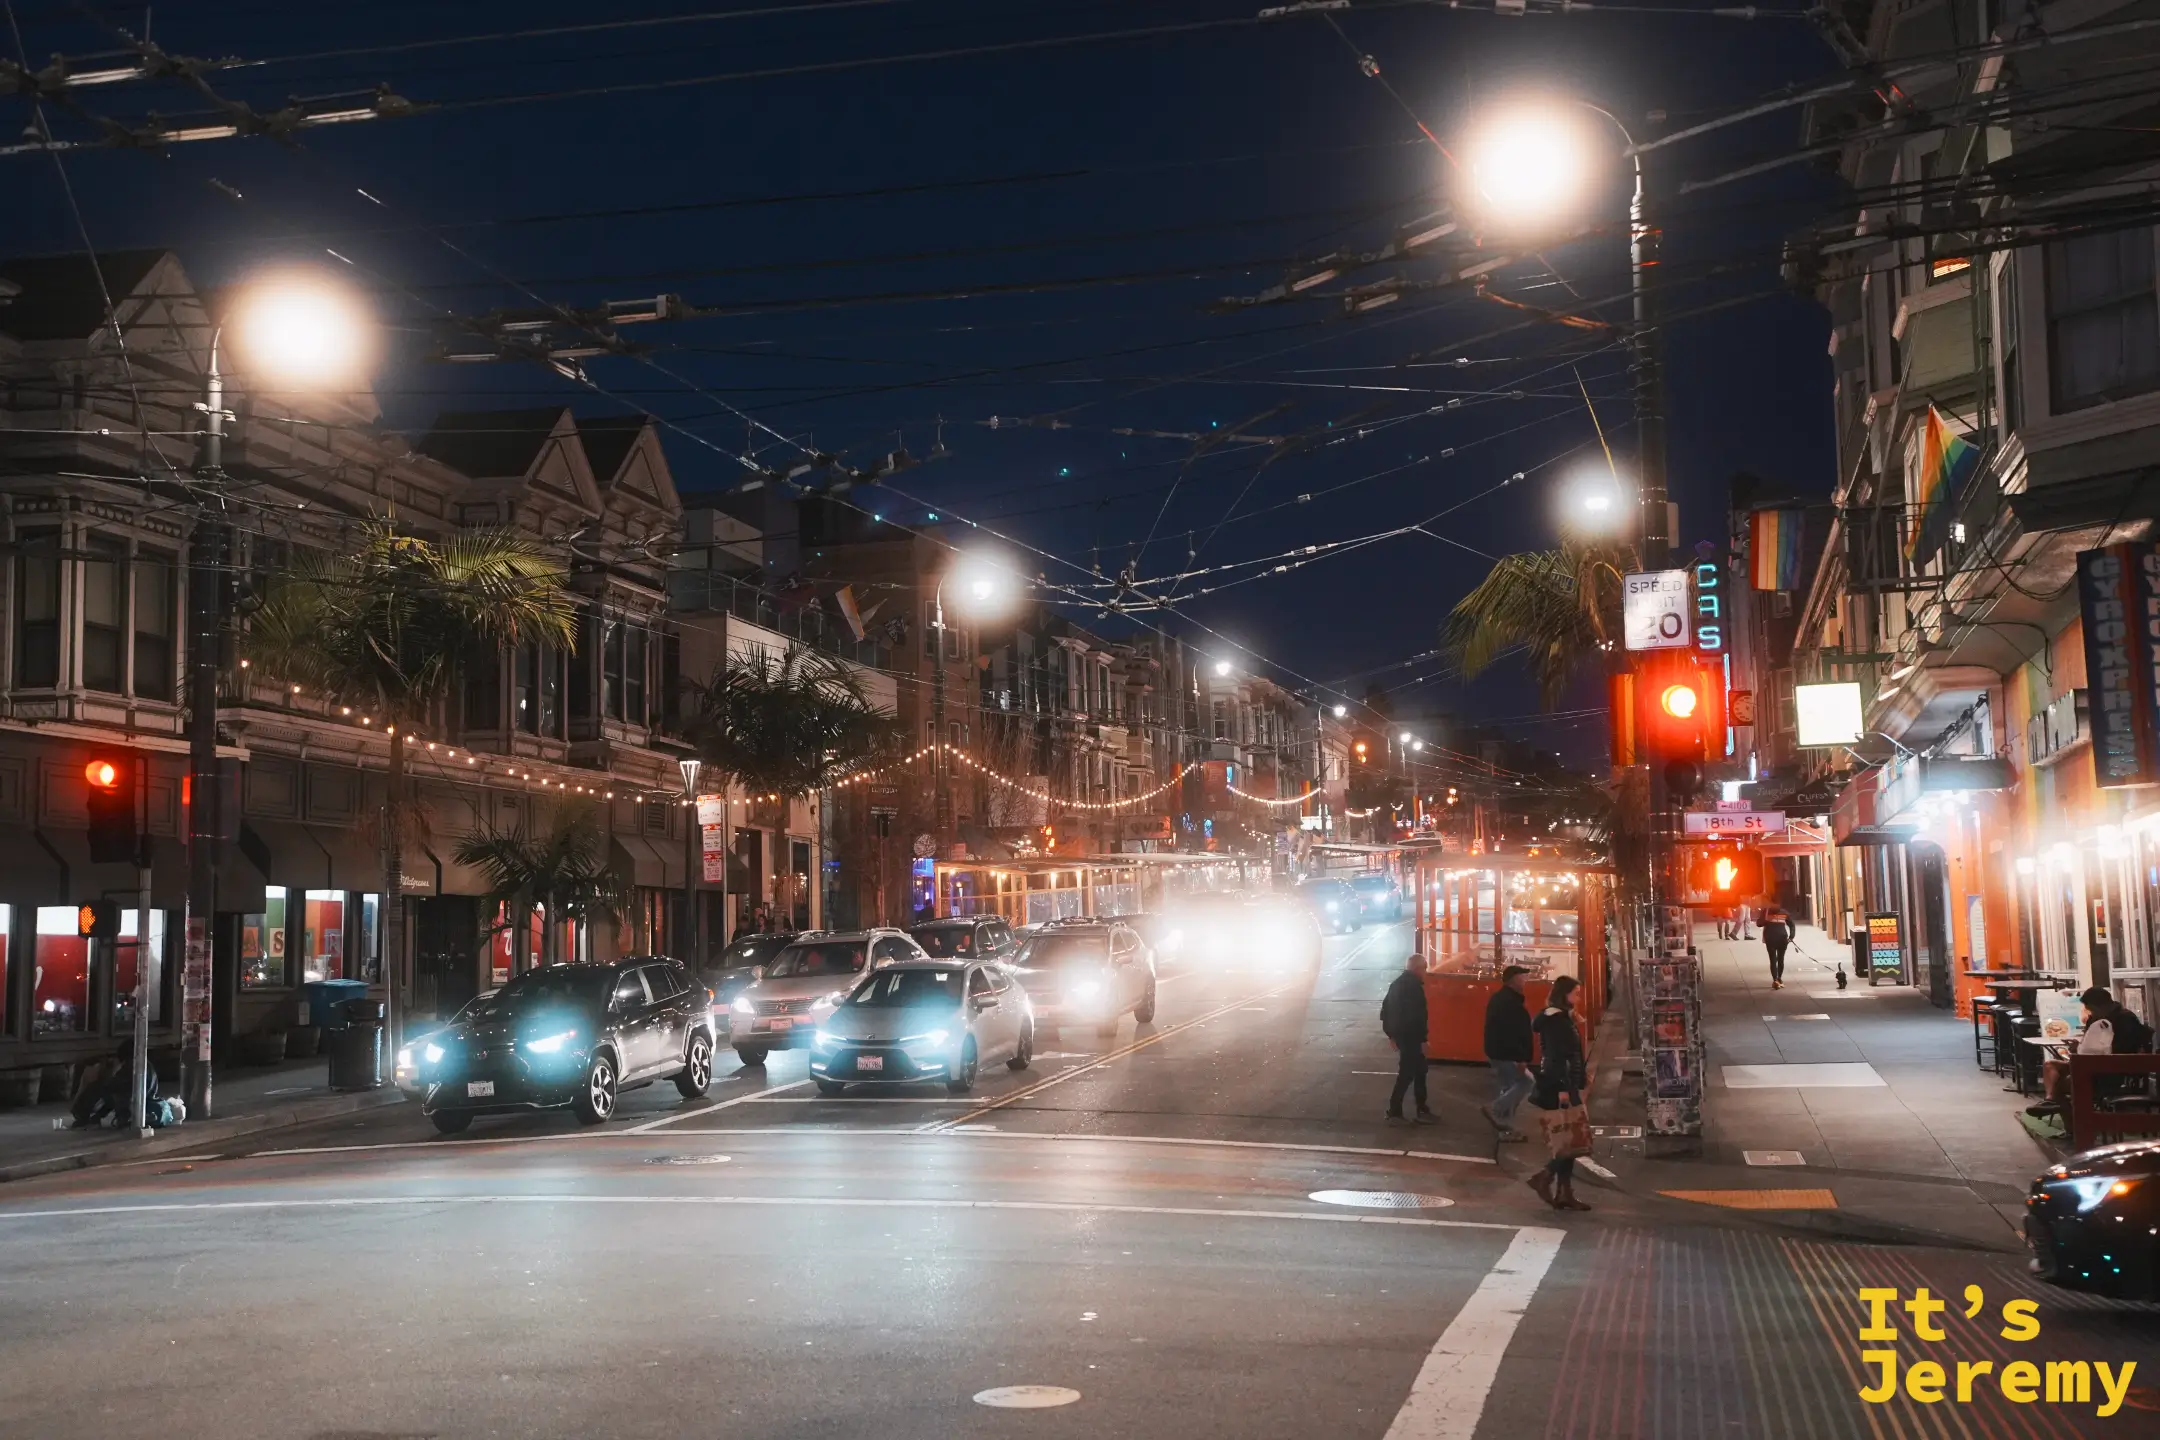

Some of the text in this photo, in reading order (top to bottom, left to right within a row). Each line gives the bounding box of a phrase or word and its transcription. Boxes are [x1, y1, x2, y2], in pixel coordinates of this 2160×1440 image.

[1630, 580, 1683, 593] SPEED
[1728, 801, 1748, 810] 4100
[1704, 816, 1763, 829] 18th St
